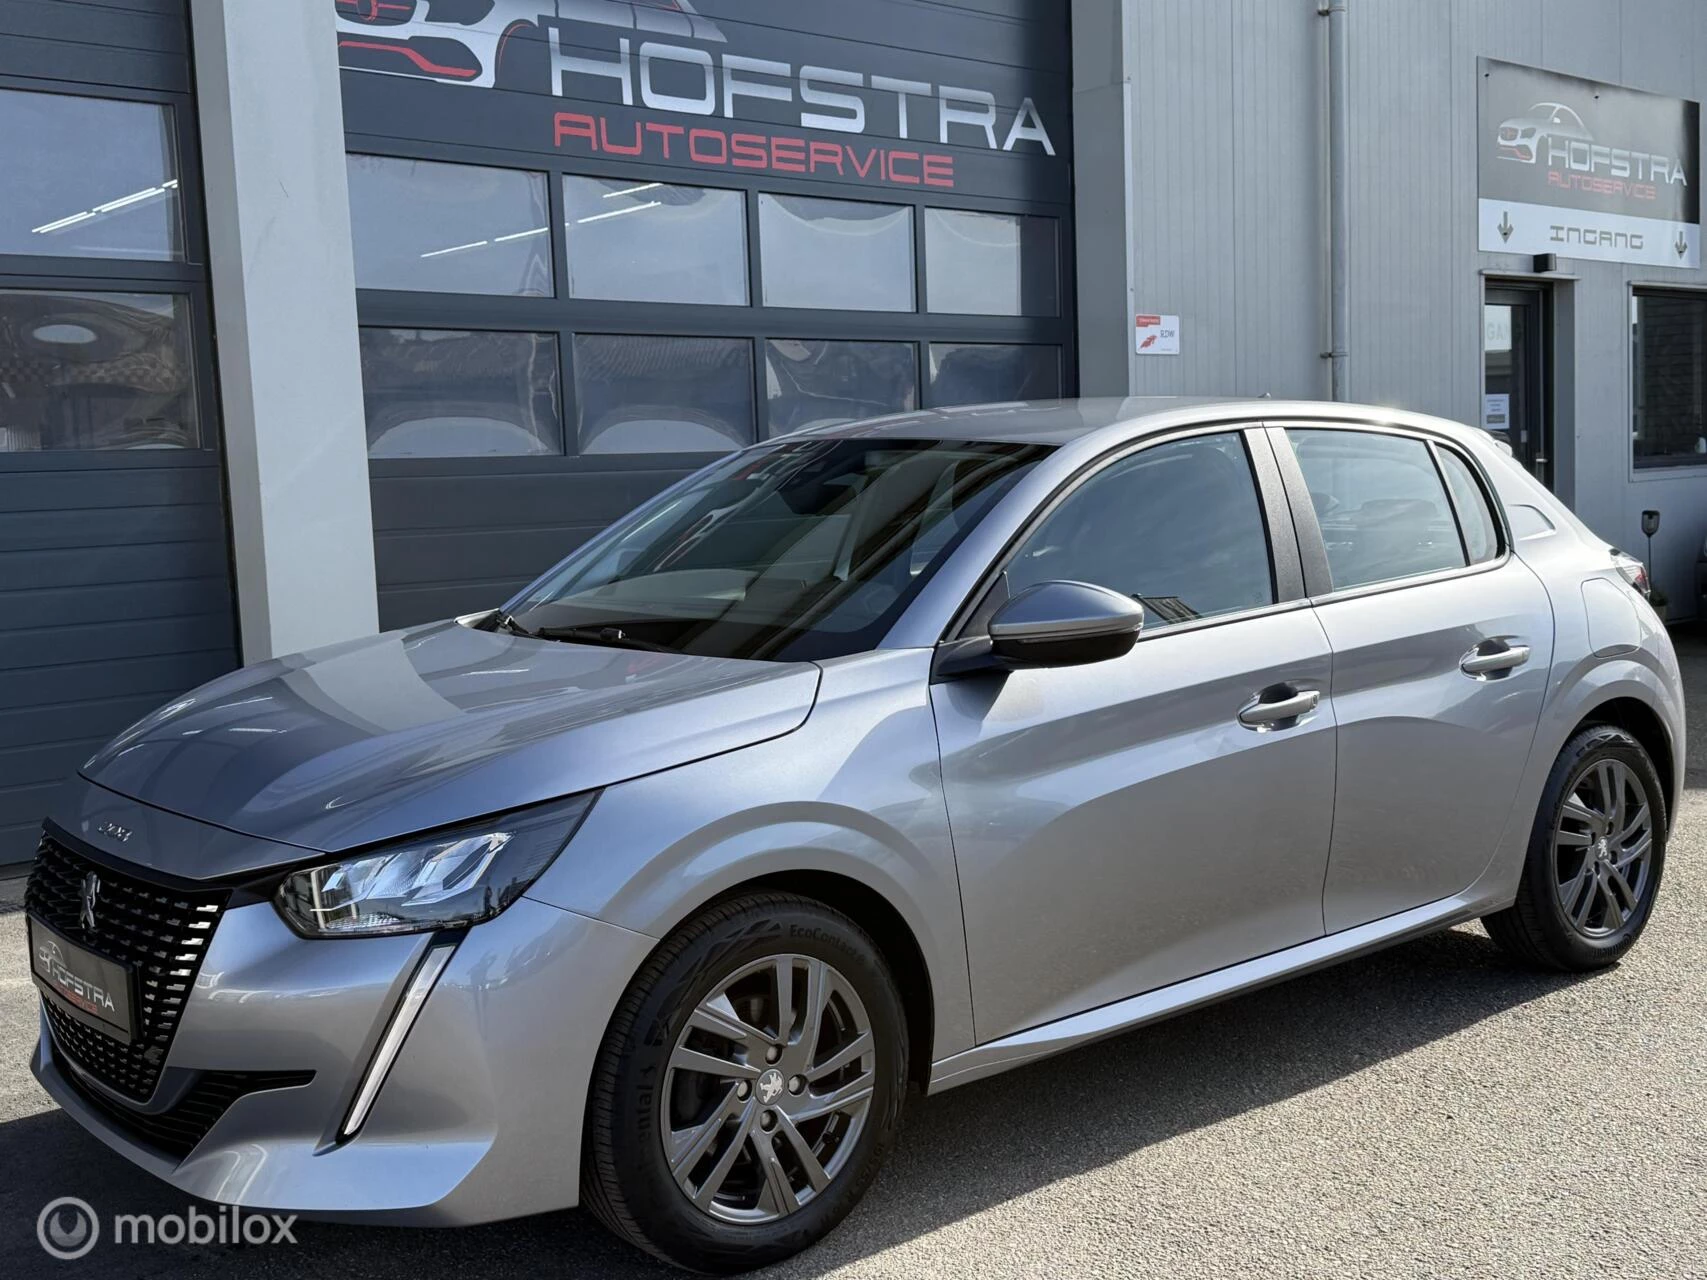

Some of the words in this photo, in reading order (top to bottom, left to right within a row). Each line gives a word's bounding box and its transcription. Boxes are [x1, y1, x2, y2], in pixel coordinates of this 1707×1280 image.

[548, 27, 1056, 157] HOFSTRA
[554, 112, 955, 188] AUTOSERVICE
[1547, 136, 1687, 187] HOFSTRA
[1547, 171, 1657, 201] AUTOSERVICE
[1550, 225, 1644, 250] INGANG
[52, 960, 115, 1012] HOFSTRA
